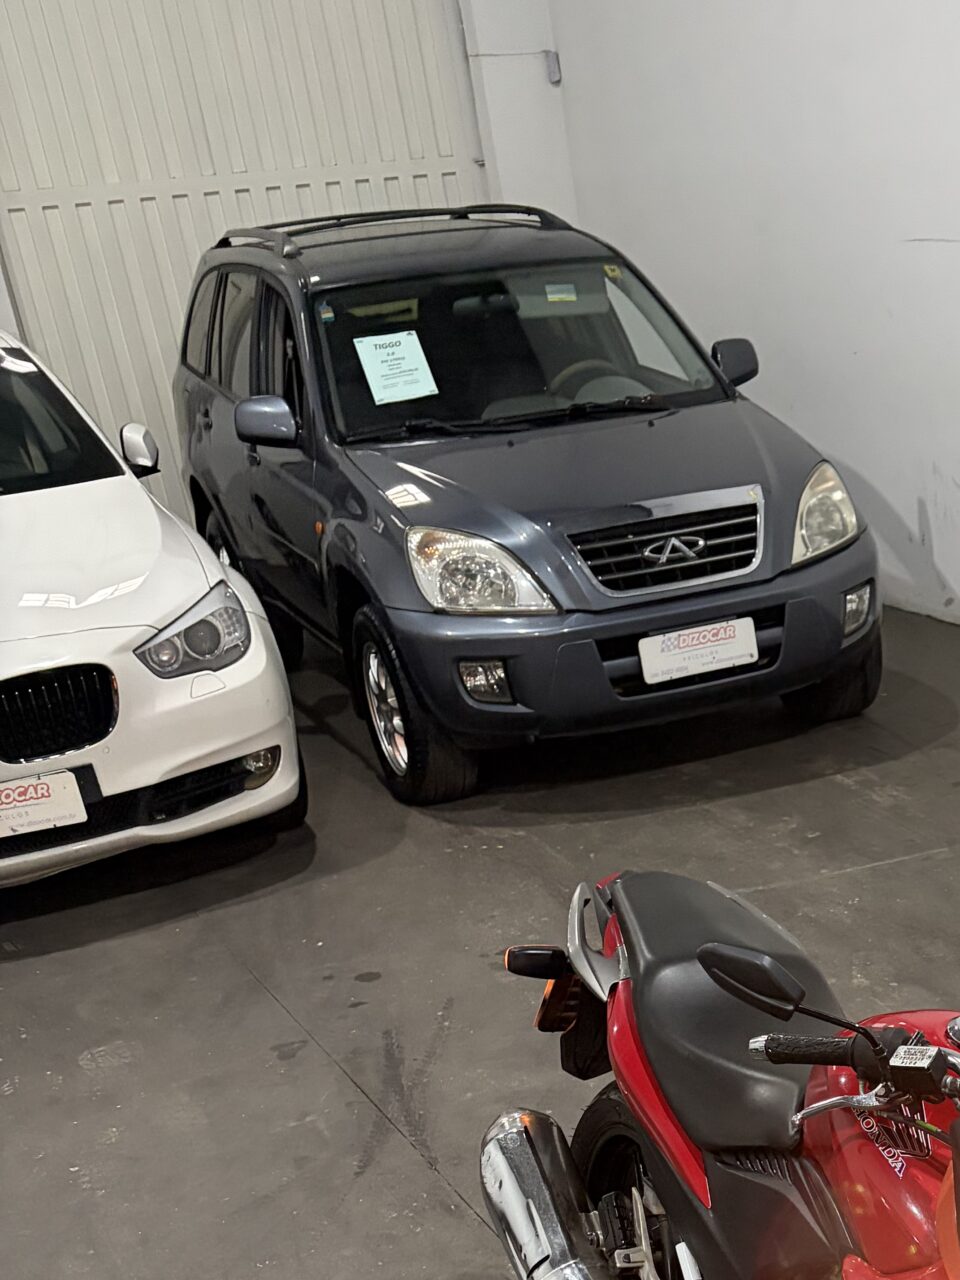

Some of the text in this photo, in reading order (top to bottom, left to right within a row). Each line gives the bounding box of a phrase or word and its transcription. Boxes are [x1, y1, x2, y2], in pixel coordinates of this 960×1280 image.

[373, 340, 402, 351] TIGGO
[677, 624, 736, 650] DIZOCAR
[0, 782, 51, 806] OCAR
